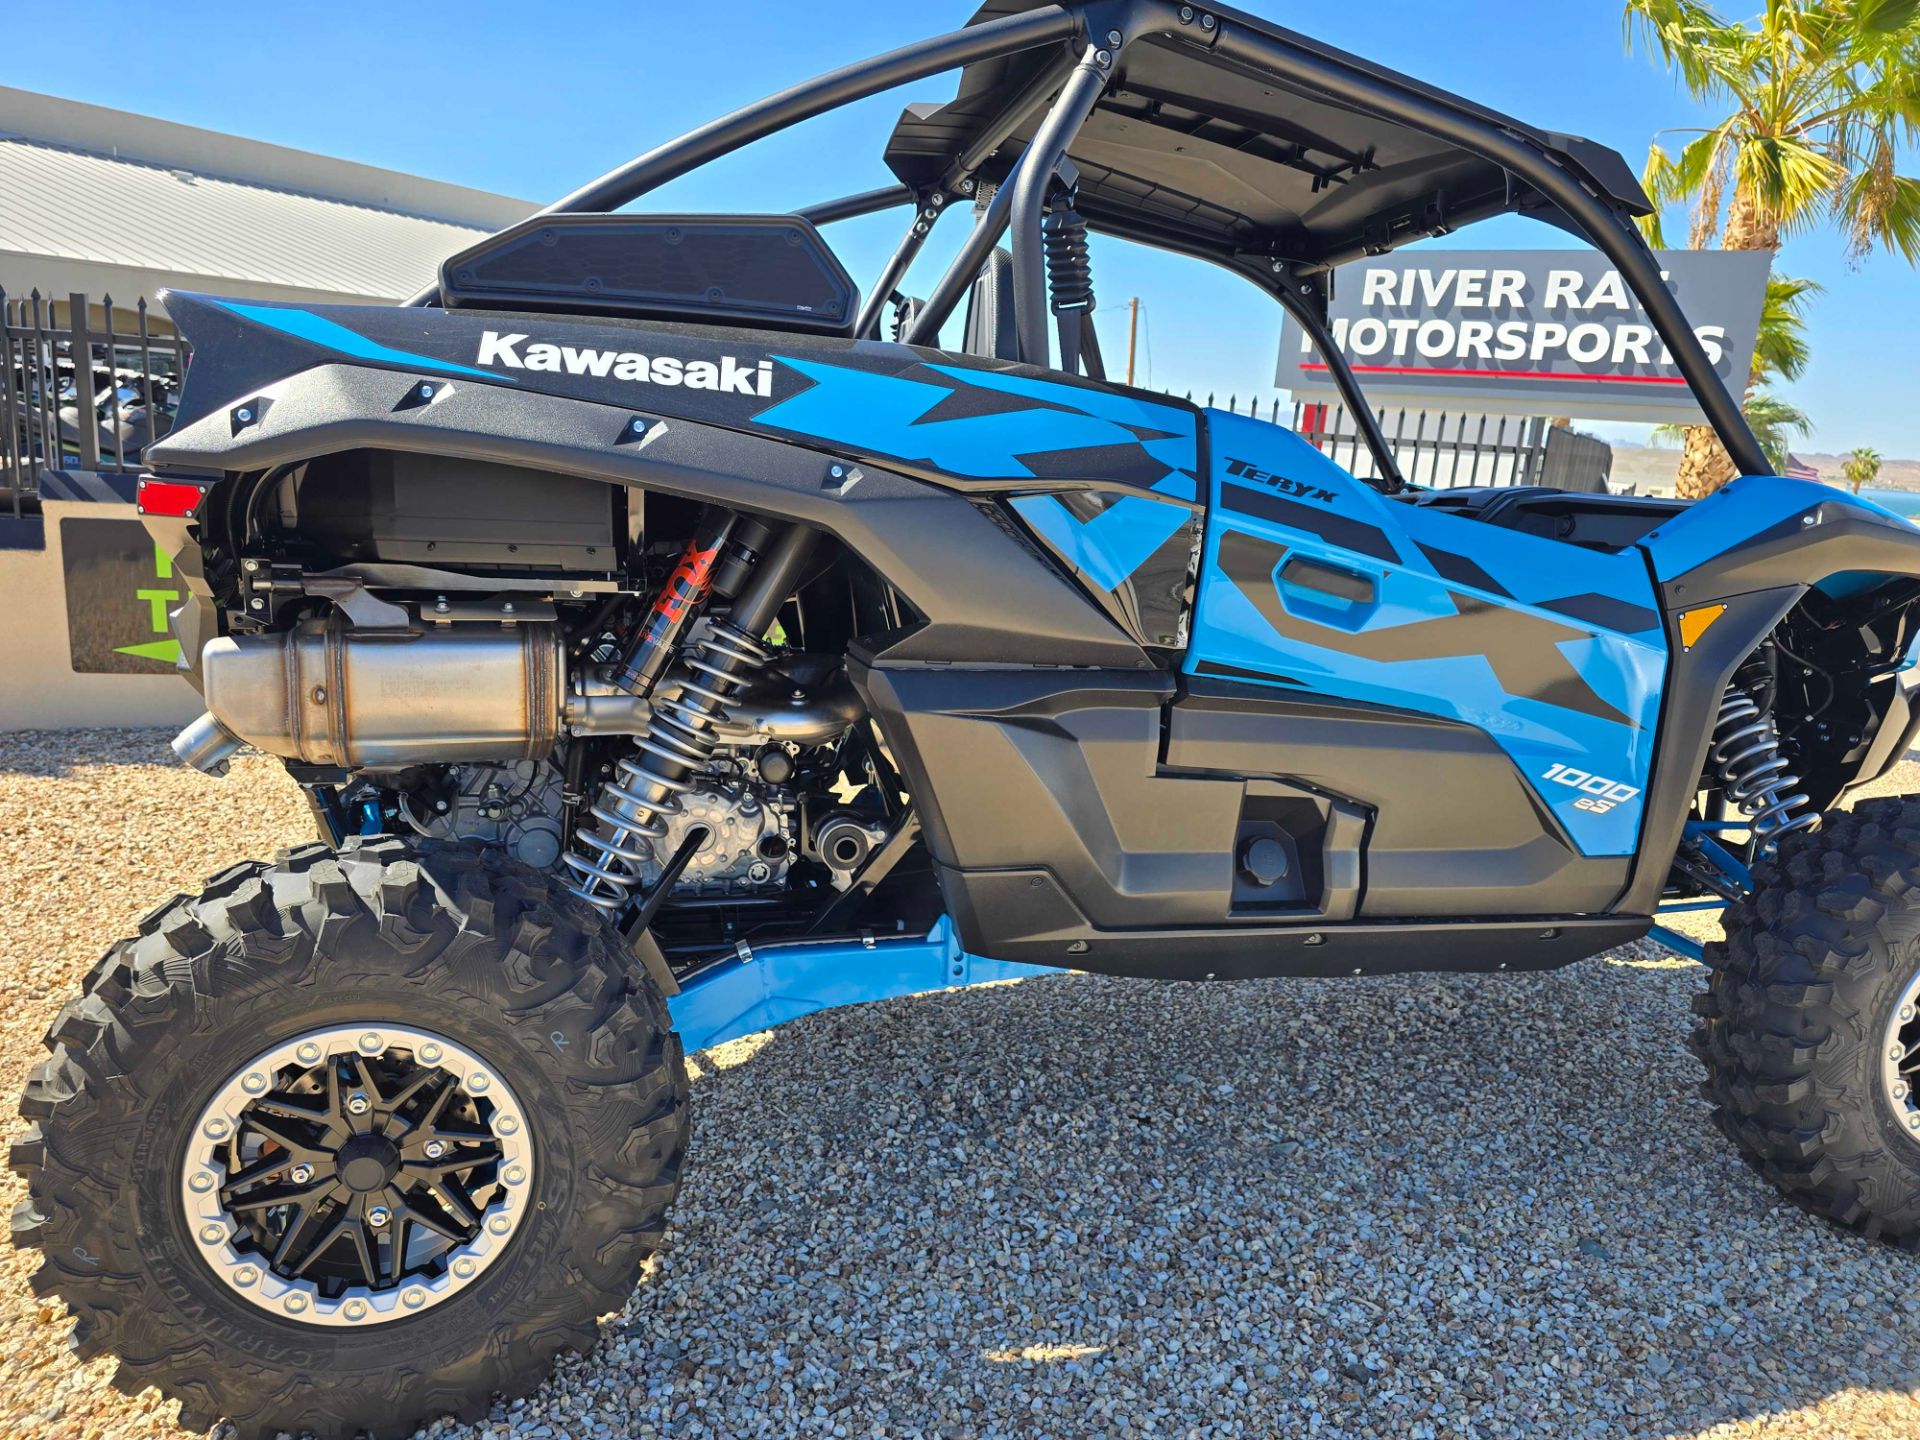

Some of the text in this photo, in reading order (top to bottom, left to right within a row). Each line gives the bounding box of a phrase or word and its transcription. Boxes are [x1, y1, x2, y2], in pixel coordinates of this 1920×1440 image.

[1362, 269, 1671, 310] RIVER RA
[477, 330, 773, 397] Kawasaki
[653, 539, 719, 624] FOX
[1541, 762, 1641, 803] 1000
